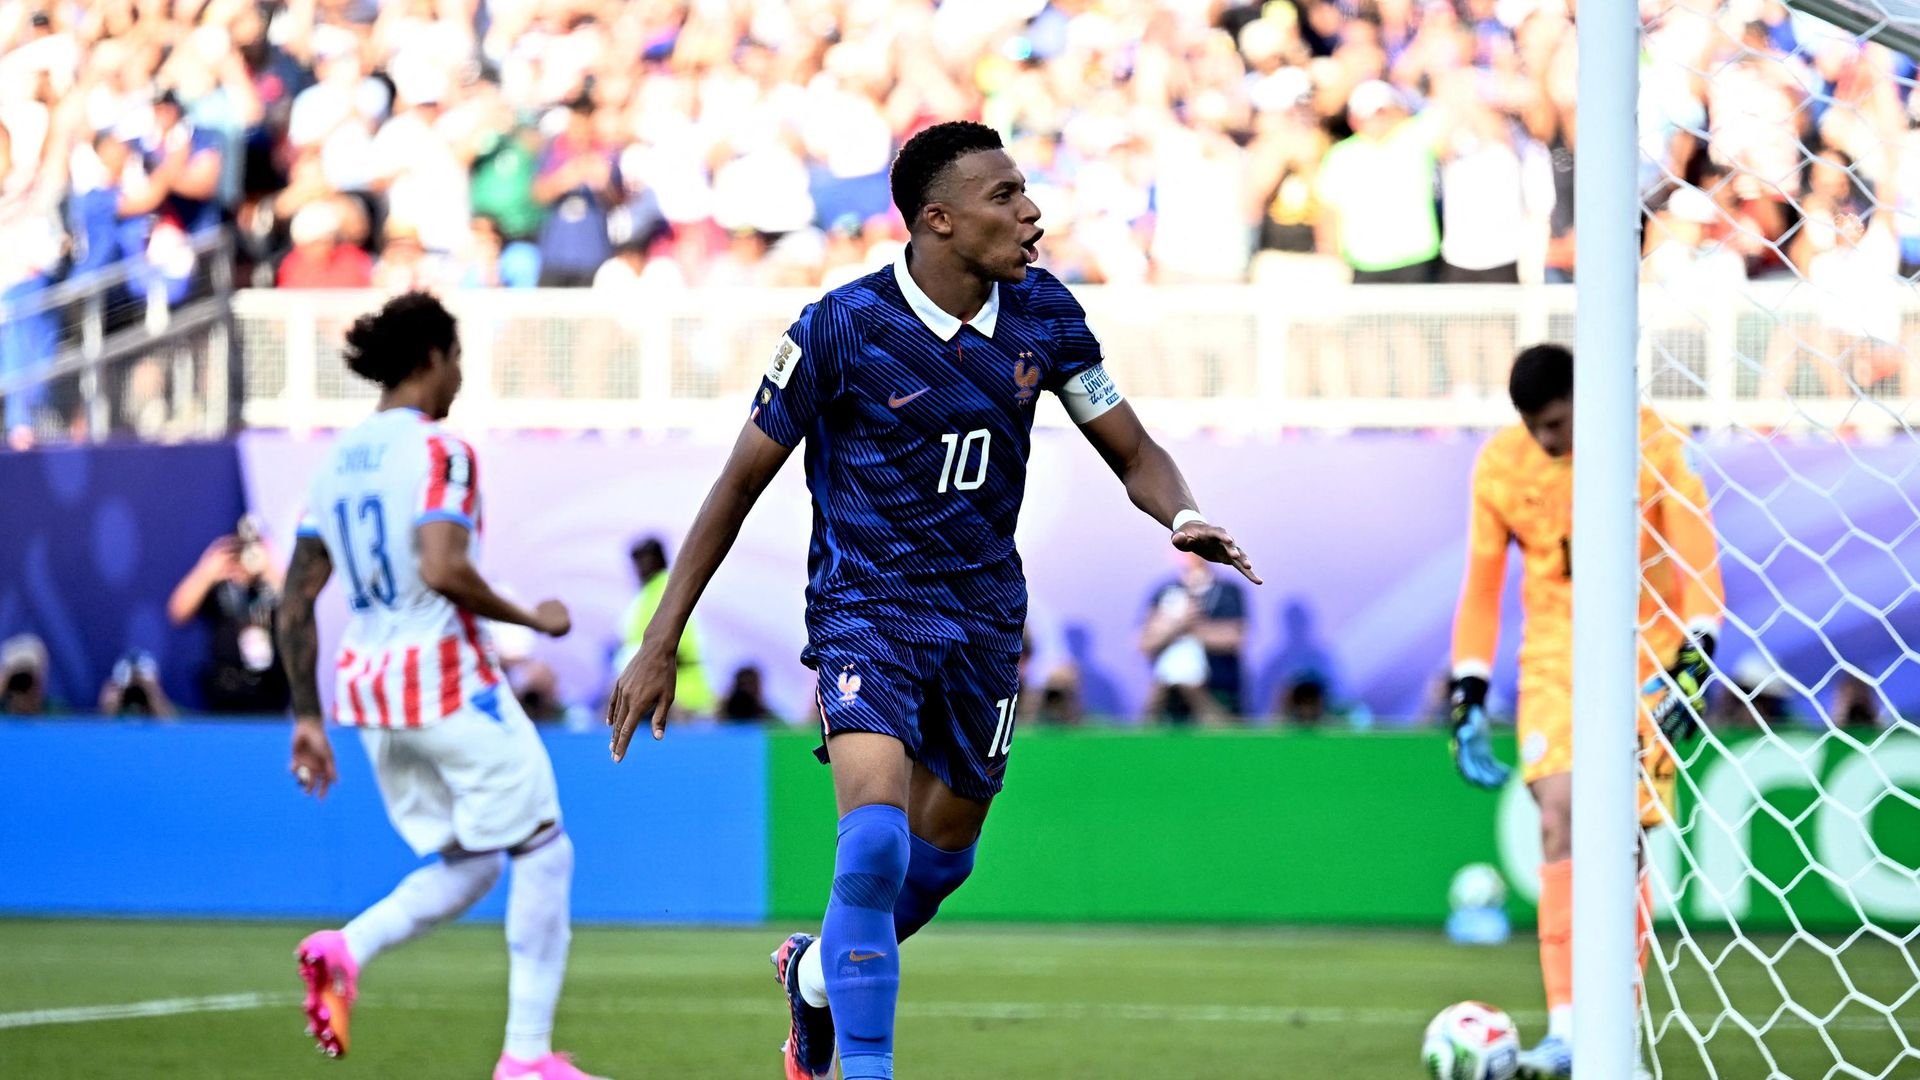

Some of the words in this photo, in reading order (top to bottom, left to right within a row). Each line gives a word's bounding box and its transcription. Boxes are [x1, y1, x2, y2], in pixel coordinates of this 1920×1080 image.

[1080, 363, 1104, 384] FOOTB
[937, 428, 991, 493] 10
[333, 494, 396, 609] 13
